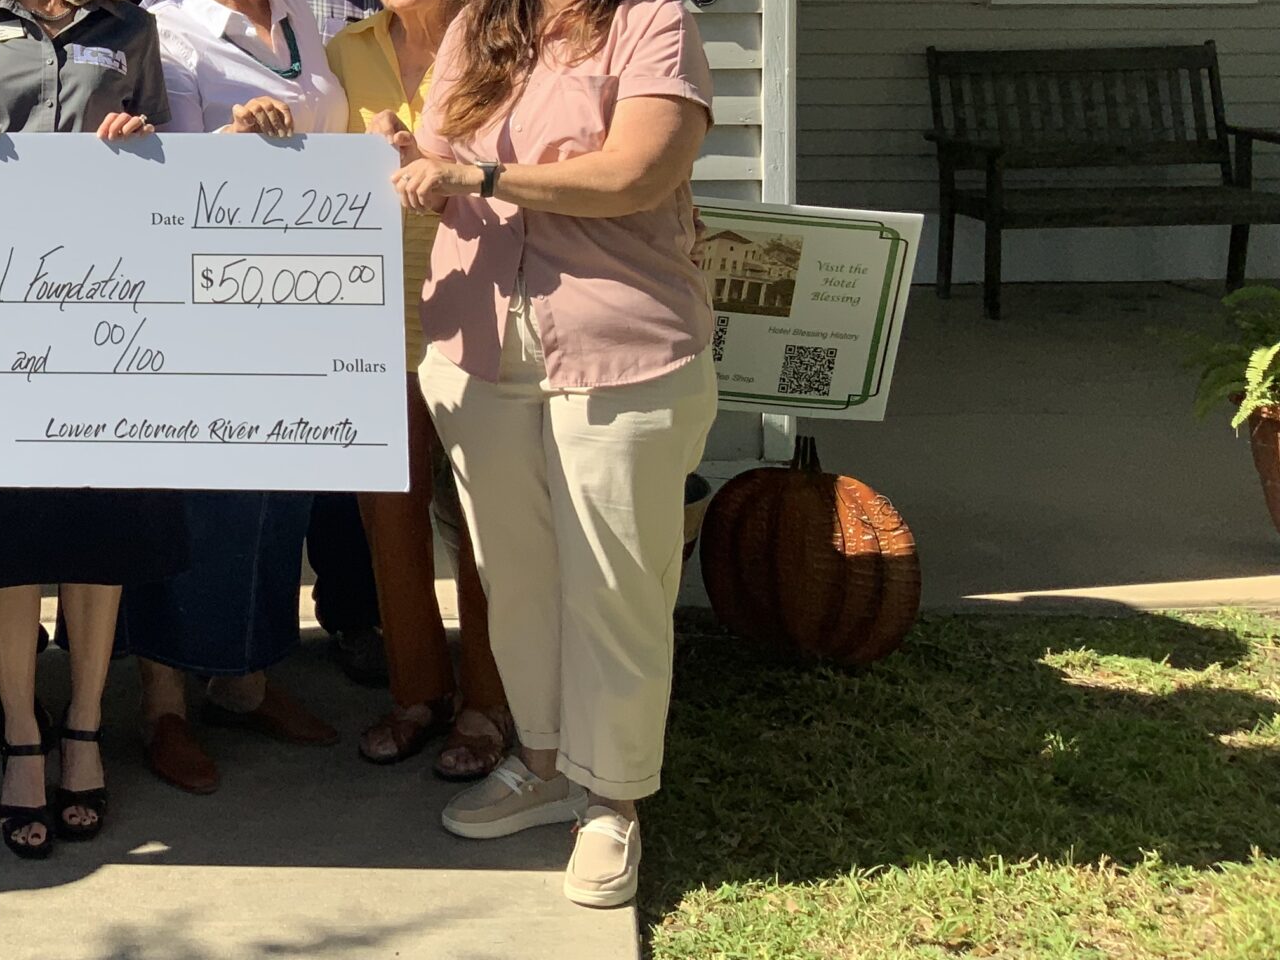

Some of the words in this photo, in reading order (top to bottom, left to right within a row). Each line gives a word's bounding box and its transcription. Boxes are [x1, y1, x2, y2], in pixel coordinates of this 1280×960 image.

[73, 43, 128, 74] LCRA
[151, 213, 185, 226] Date
[817, 260, 845, 273] Visit
[848, 263, 869, 275] the
[24, 246, 146, 313] Foundation
[821, 277, 857, 288] Hotel
[810, 291, 861, 307] Blessing
[768, 326, 791, 335] Hotel
[792, 328, 828, 340] Blessing
[830, 331, 859, 341] History
[11, 346, 51, 382] and
[332, 359, 386, 373] Dollars
[45, 418, 107, 439] Lower
[115, 418, 200, 441] Colorado
[208, 418, 259, 444] River
[266, 418, 358, 448] Authority
